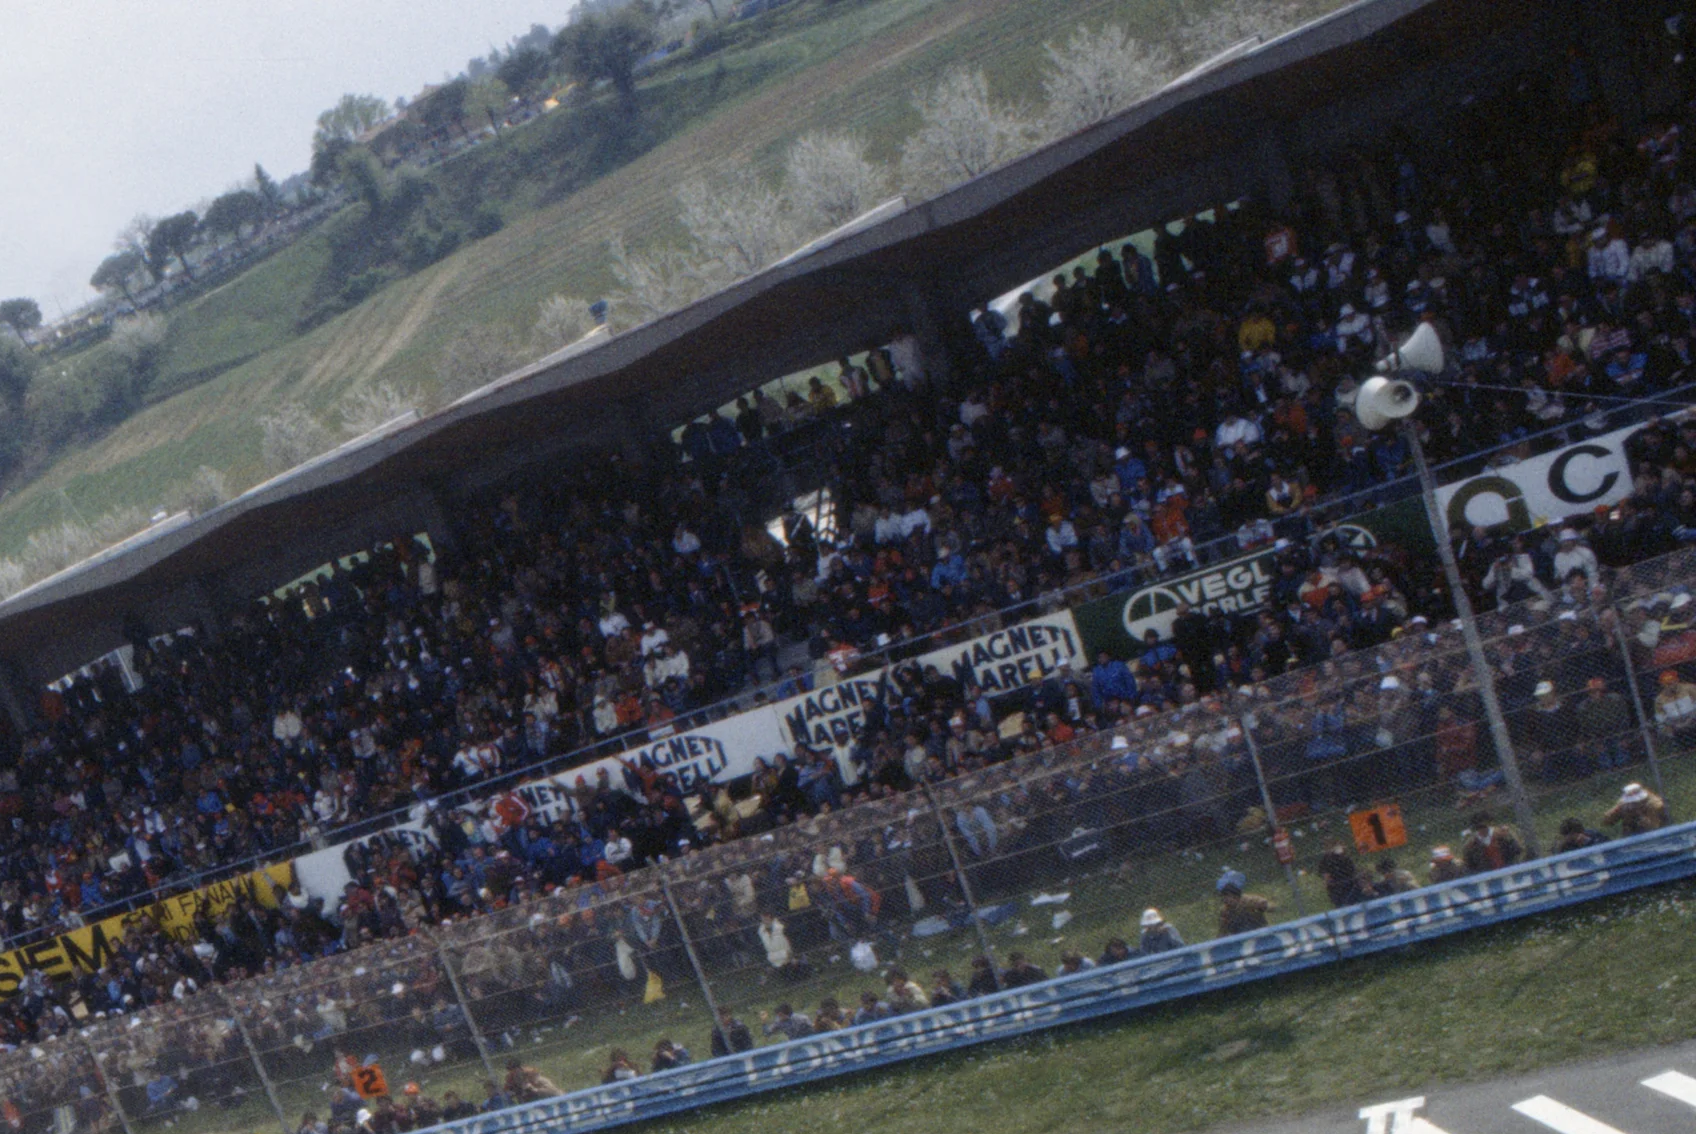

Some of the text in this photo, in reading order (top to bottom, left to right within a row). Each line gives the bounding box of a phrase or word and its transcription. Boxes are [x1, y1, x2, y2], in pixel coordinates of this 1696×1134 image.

[1176, 559, 1272, 605] VEGL
[951, 625, 1077, 688] MAGNETI
[1368, 812, 1388, 846] 1
[357, 1067, 382, 1097] 2
